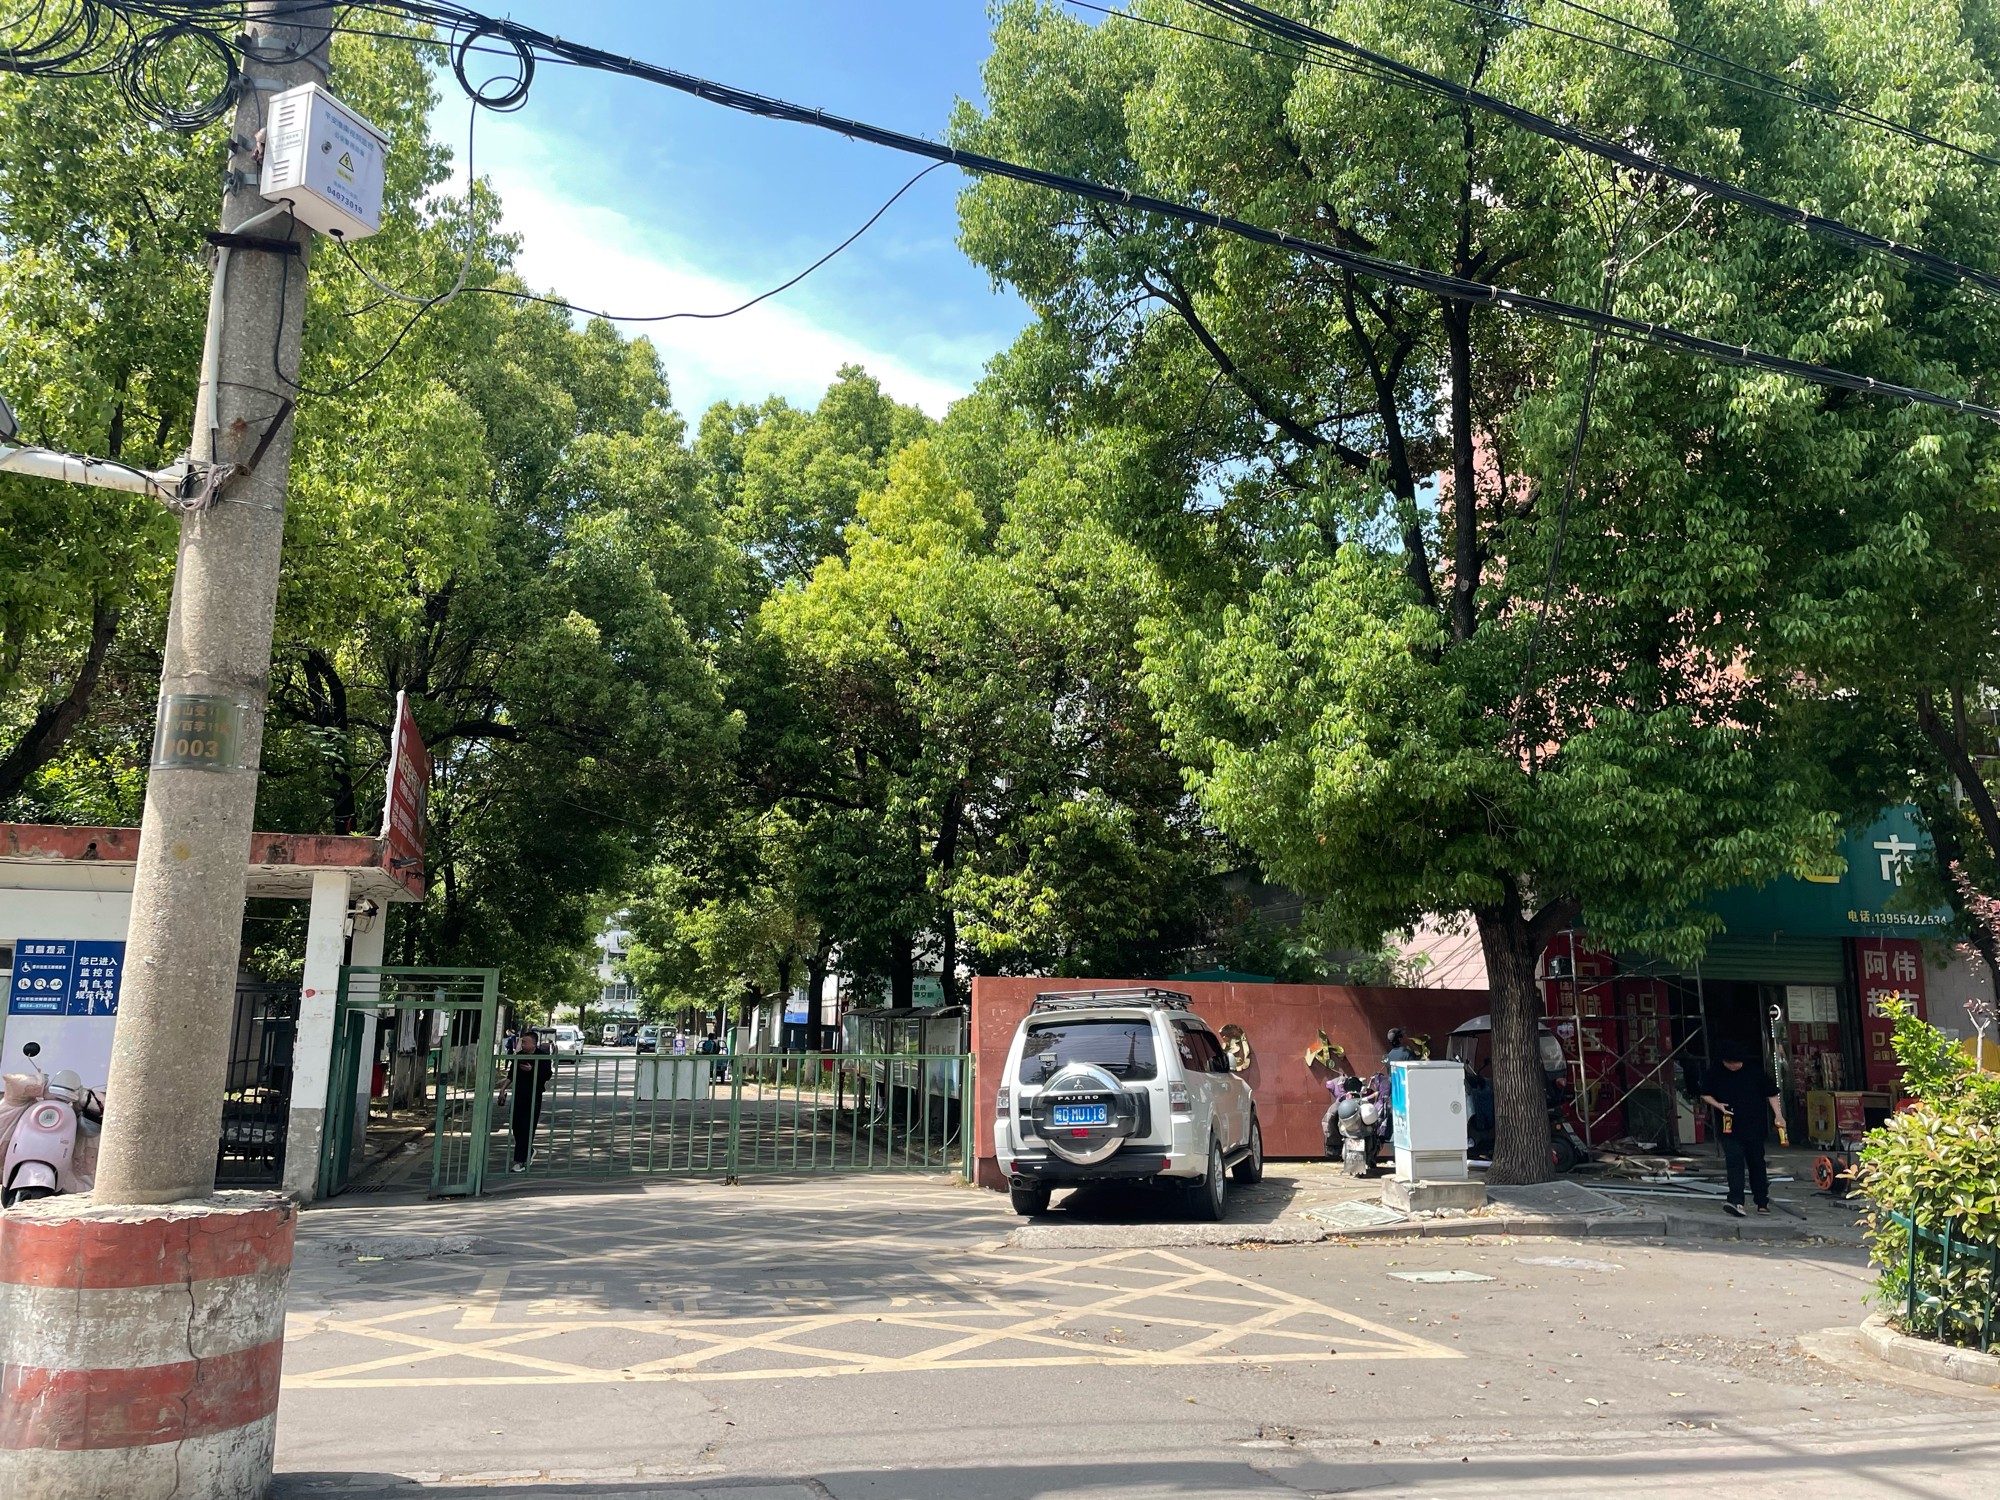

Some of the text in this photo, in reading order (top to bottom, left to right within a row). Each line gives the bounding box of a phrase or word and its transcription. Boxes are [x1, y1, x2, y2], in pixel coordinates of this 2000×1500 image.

[326, 186, 363, 214] 04073019
[79, 956, 118, 966] 您已进入
[1864, 950, 1917, 982] 阿伟
[80, 968, 115, 977] 监控区
[79, 979, 114, 989] 请自觉
[75, 990, 114, 1000] 规范行为
[1867, 987, 1920, 1018] 超市
